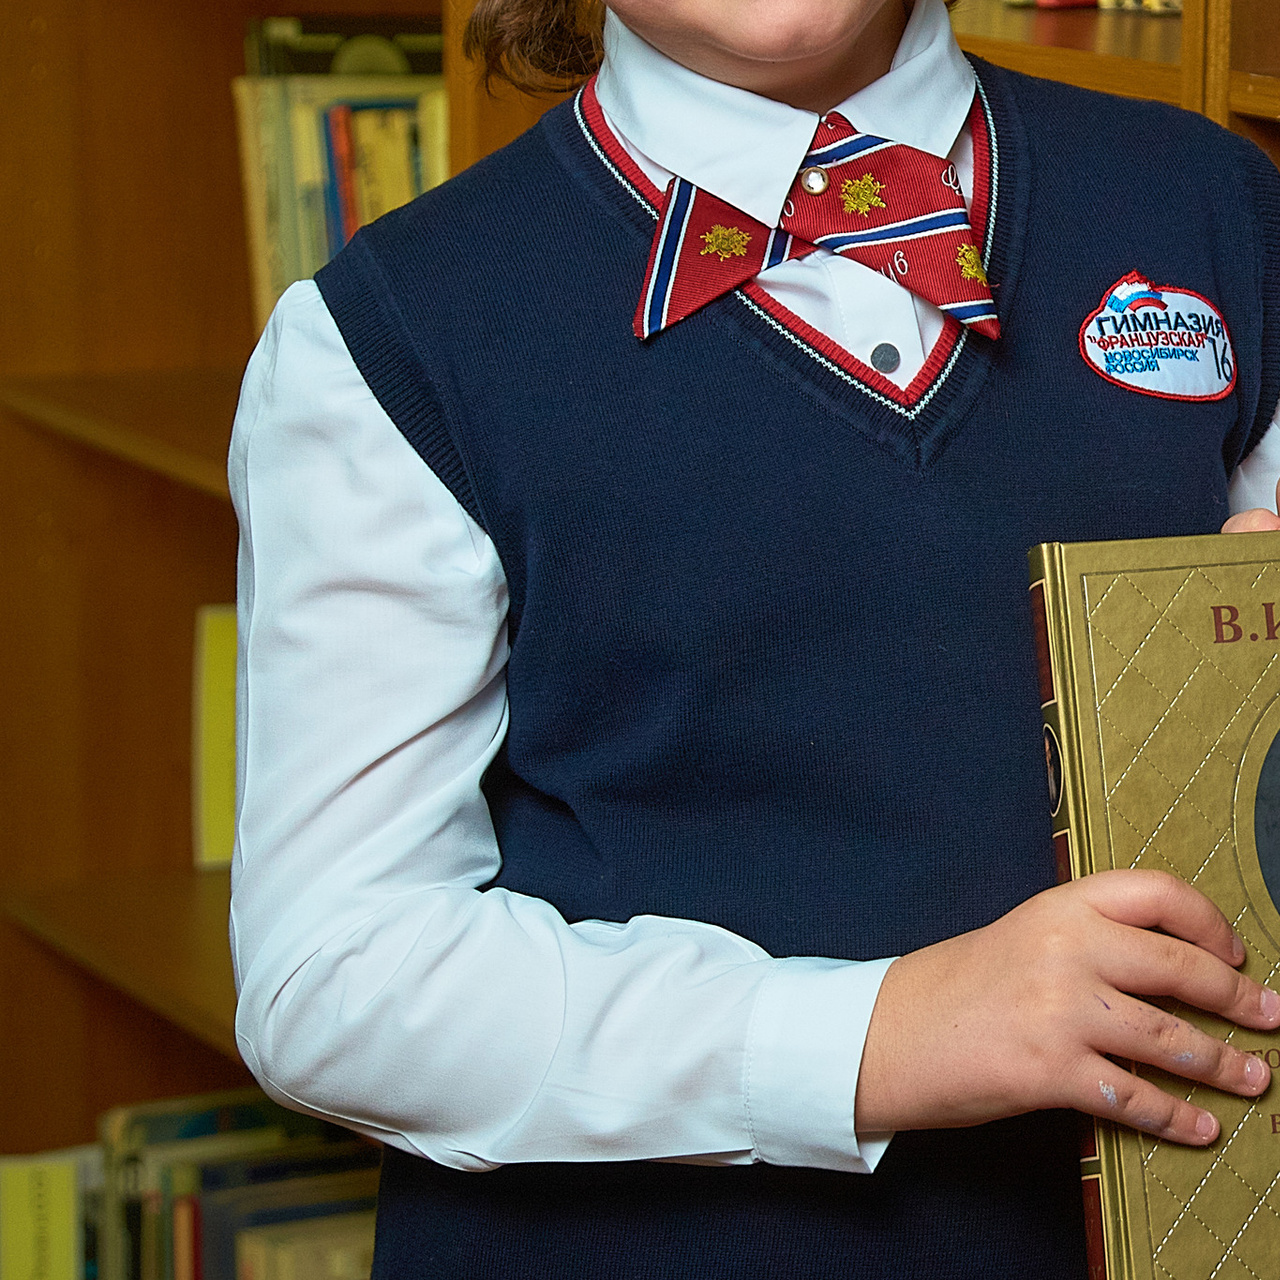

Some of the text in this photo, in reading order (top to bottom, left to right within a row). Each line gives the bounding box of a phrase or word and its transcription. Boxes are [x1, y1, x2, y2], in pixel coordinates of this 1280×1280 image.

[1095, 311, 1226, 340] ГИМНАЗИЯ
[1103, 347, 1200, 363] НОВОСИБИРСК
[1207, 336, 1234, 383] 16
[1104, 359, 1161, 376] РОССИЯ
